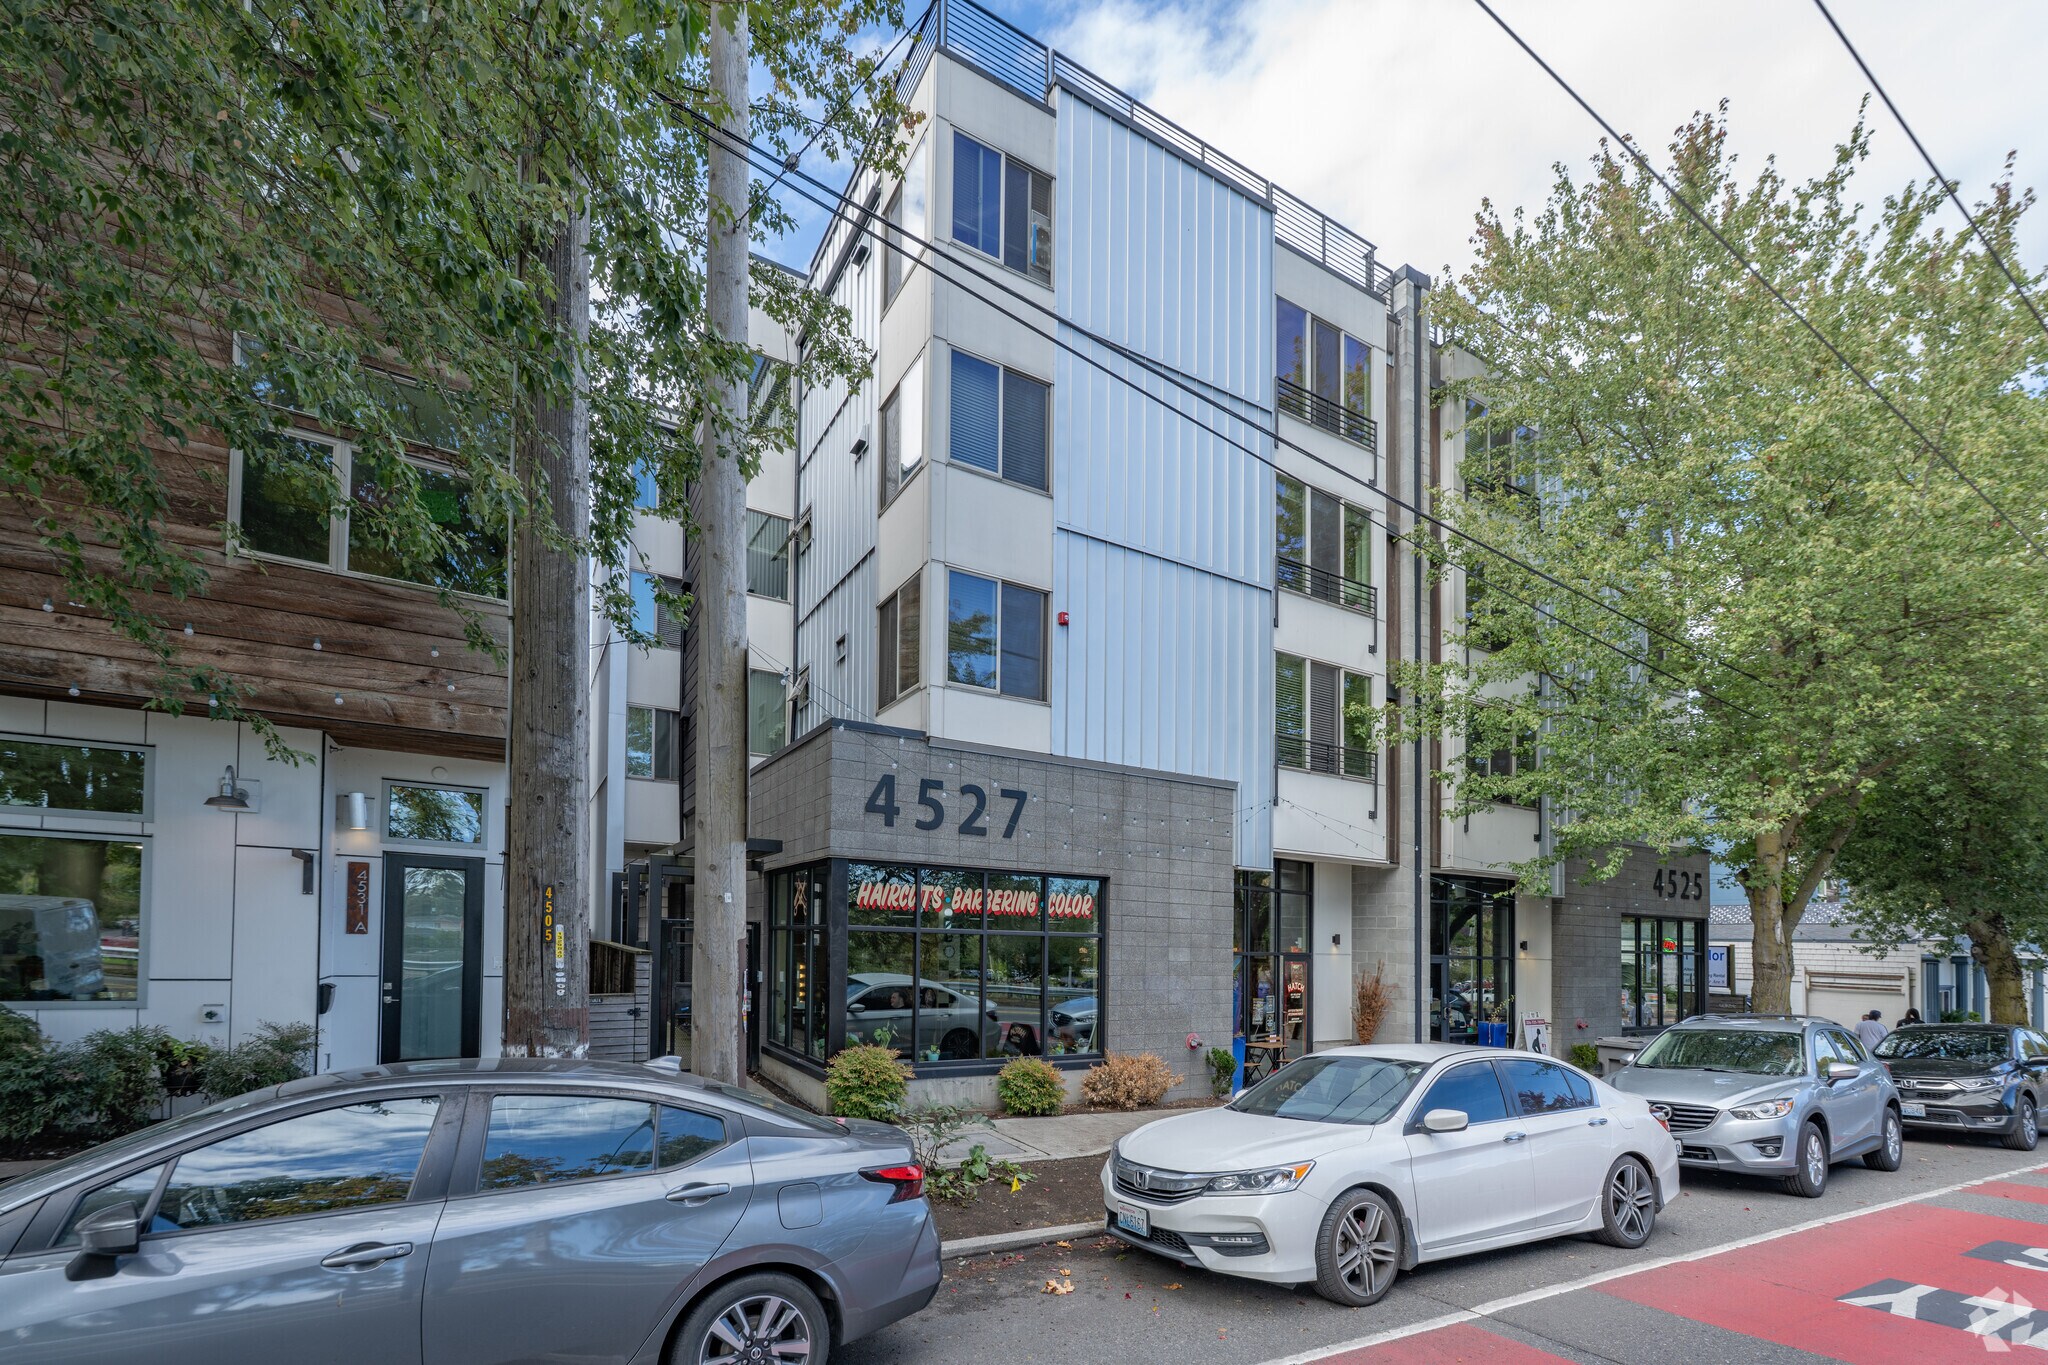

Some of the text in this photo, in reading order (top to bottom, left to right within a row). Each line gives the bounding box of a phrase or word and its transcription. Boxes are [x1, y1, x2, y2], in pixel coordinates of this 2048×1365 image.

[864, 774, 1028, 839] 4527
[354, 869, 368, 933] 4531 A
[856, 881, 1095, 919] HAIRCUTS BARBERING COLOR
[1653, 868, 1703, 901] 4525
[544, 886, 553, 942] 4505
[1708, 949, 1725, 961] lor
[1287, 982, 1305, 993] HATCH
